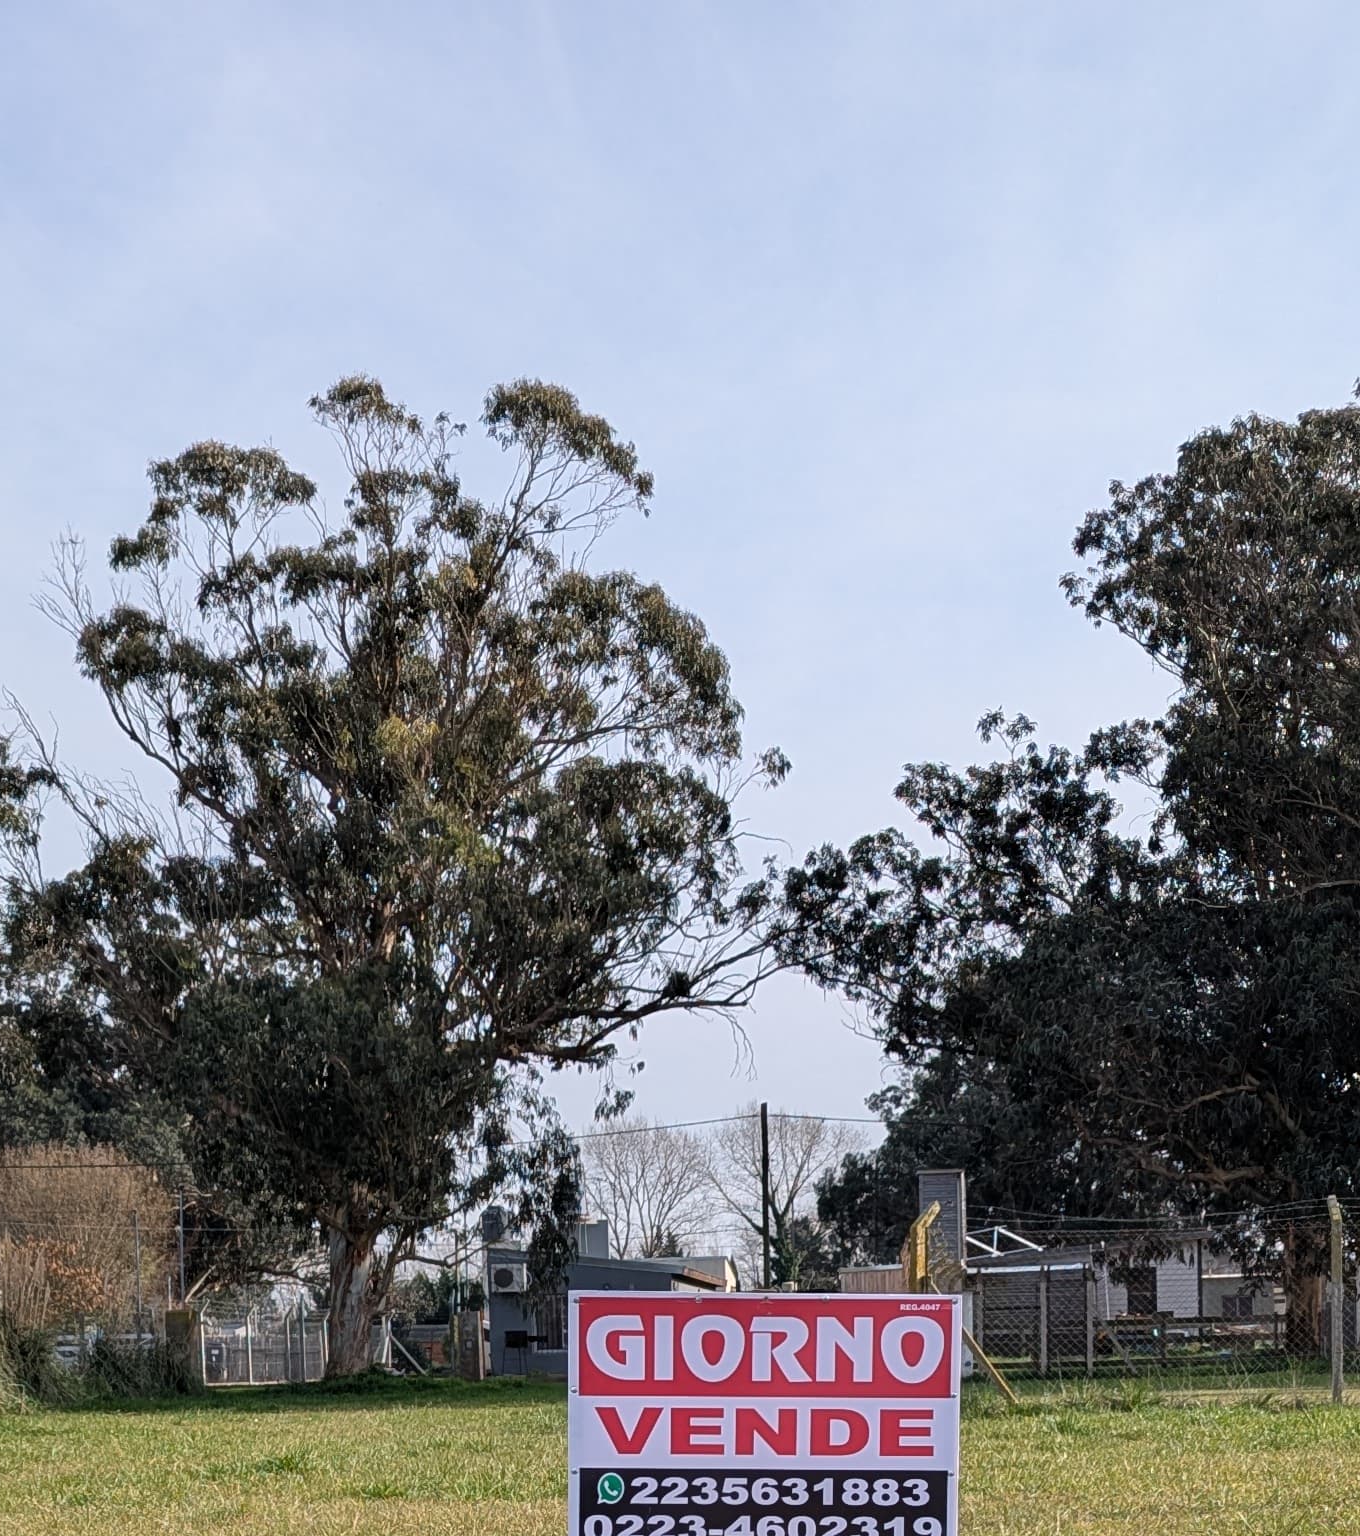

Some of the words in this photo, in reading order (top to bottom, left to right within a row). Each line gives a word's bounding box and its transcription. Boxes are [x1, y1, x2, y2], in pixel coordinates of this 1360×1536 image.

[586, 1314, 944, 1384] GIORNO
[595, 1407, 935, 1456] VENDE
[630, 1477, 930, 1506] 2235631883
